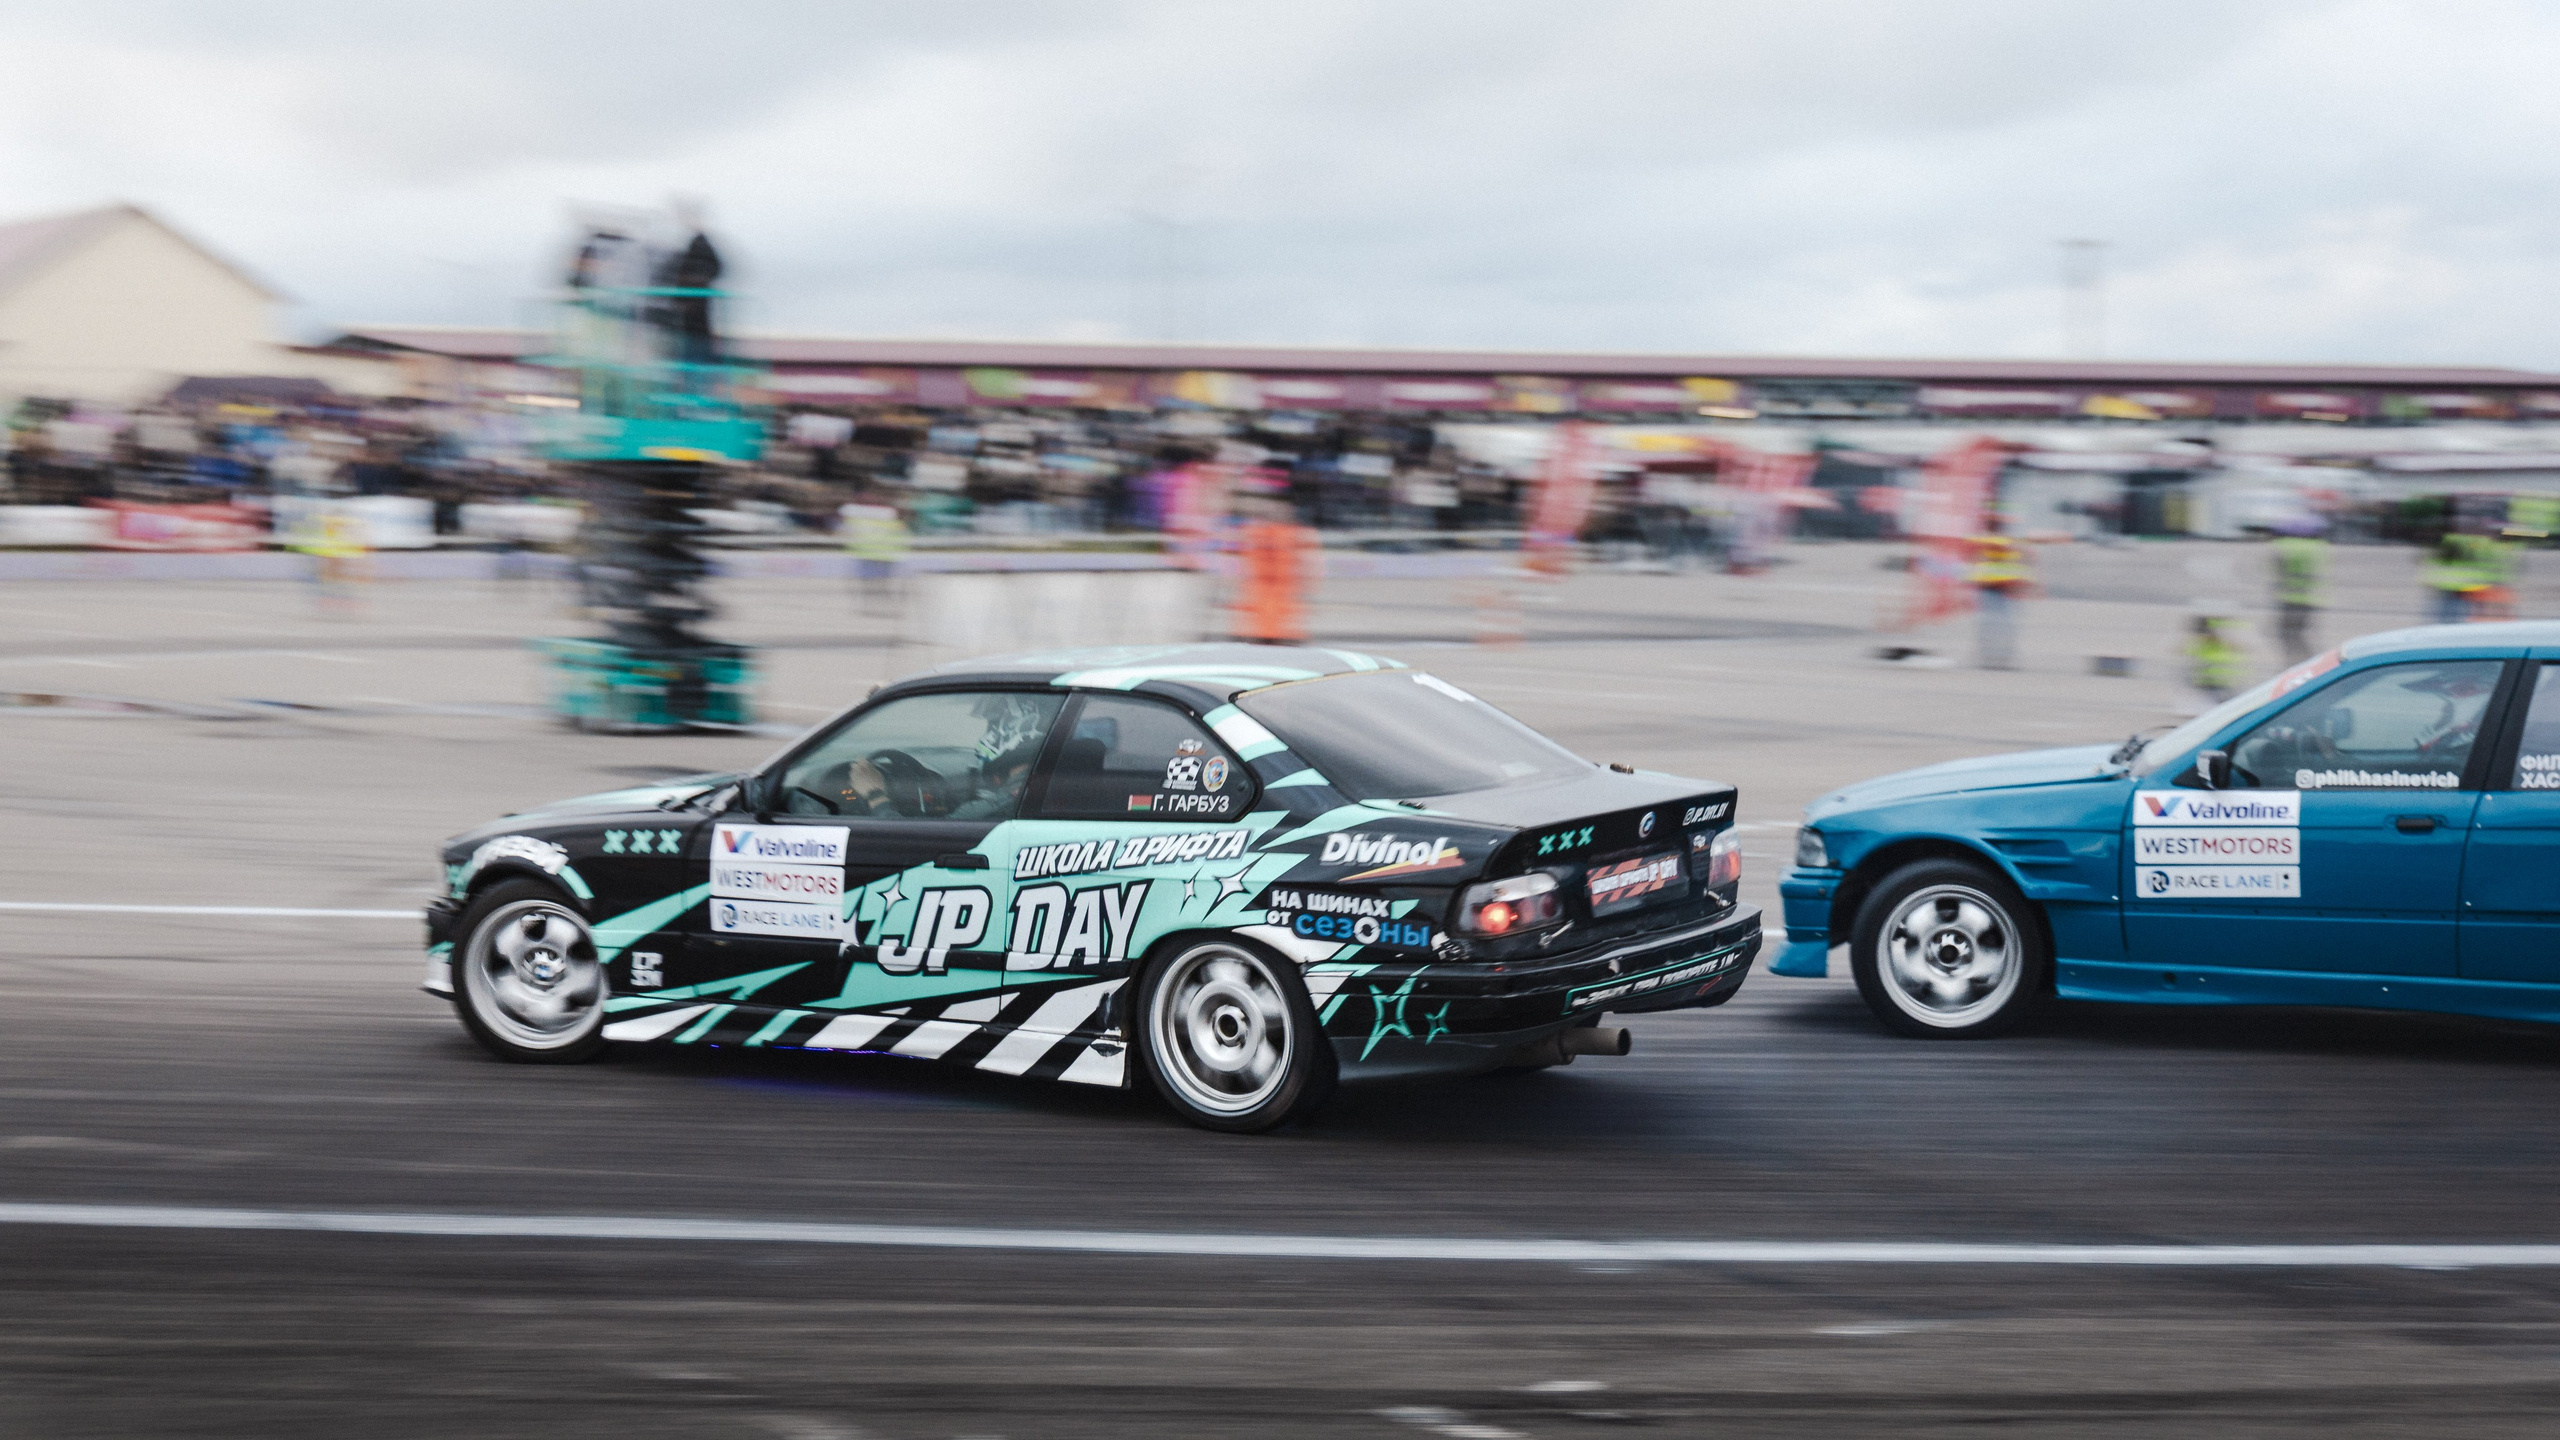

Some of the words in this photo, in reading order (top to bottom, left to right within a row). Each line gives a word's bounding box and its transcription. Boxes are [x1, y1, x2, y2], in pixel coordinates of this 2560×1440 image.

[1153, 794, 1165, 812] Г.
[1168, 794, 1230, 813] ГАРБУЗ
[2187, 802, 2289, 819] Valvoline
[754, 837, 838, 858] Valvoline
[1013, 839, 1120, 881] ШКОЛА
[1113, 829, 1250, 870] ДРИФТА
[1319, 832, 1450, 866] Divinol
[2142, 837, 2293, 855] WESTMOTORS
[715, 867, 839, 895] WESTMOTORS
[2174, 875, 2220, 889] RACE
[2224, 875, 2273, 890] LANE
[1271, 889, 1303, 910] НА
[1306, 892, 1391, 918] ШИНАХ
[876, 884, 993, 976] JP
[1004, 879, 1154, 973] DAY
